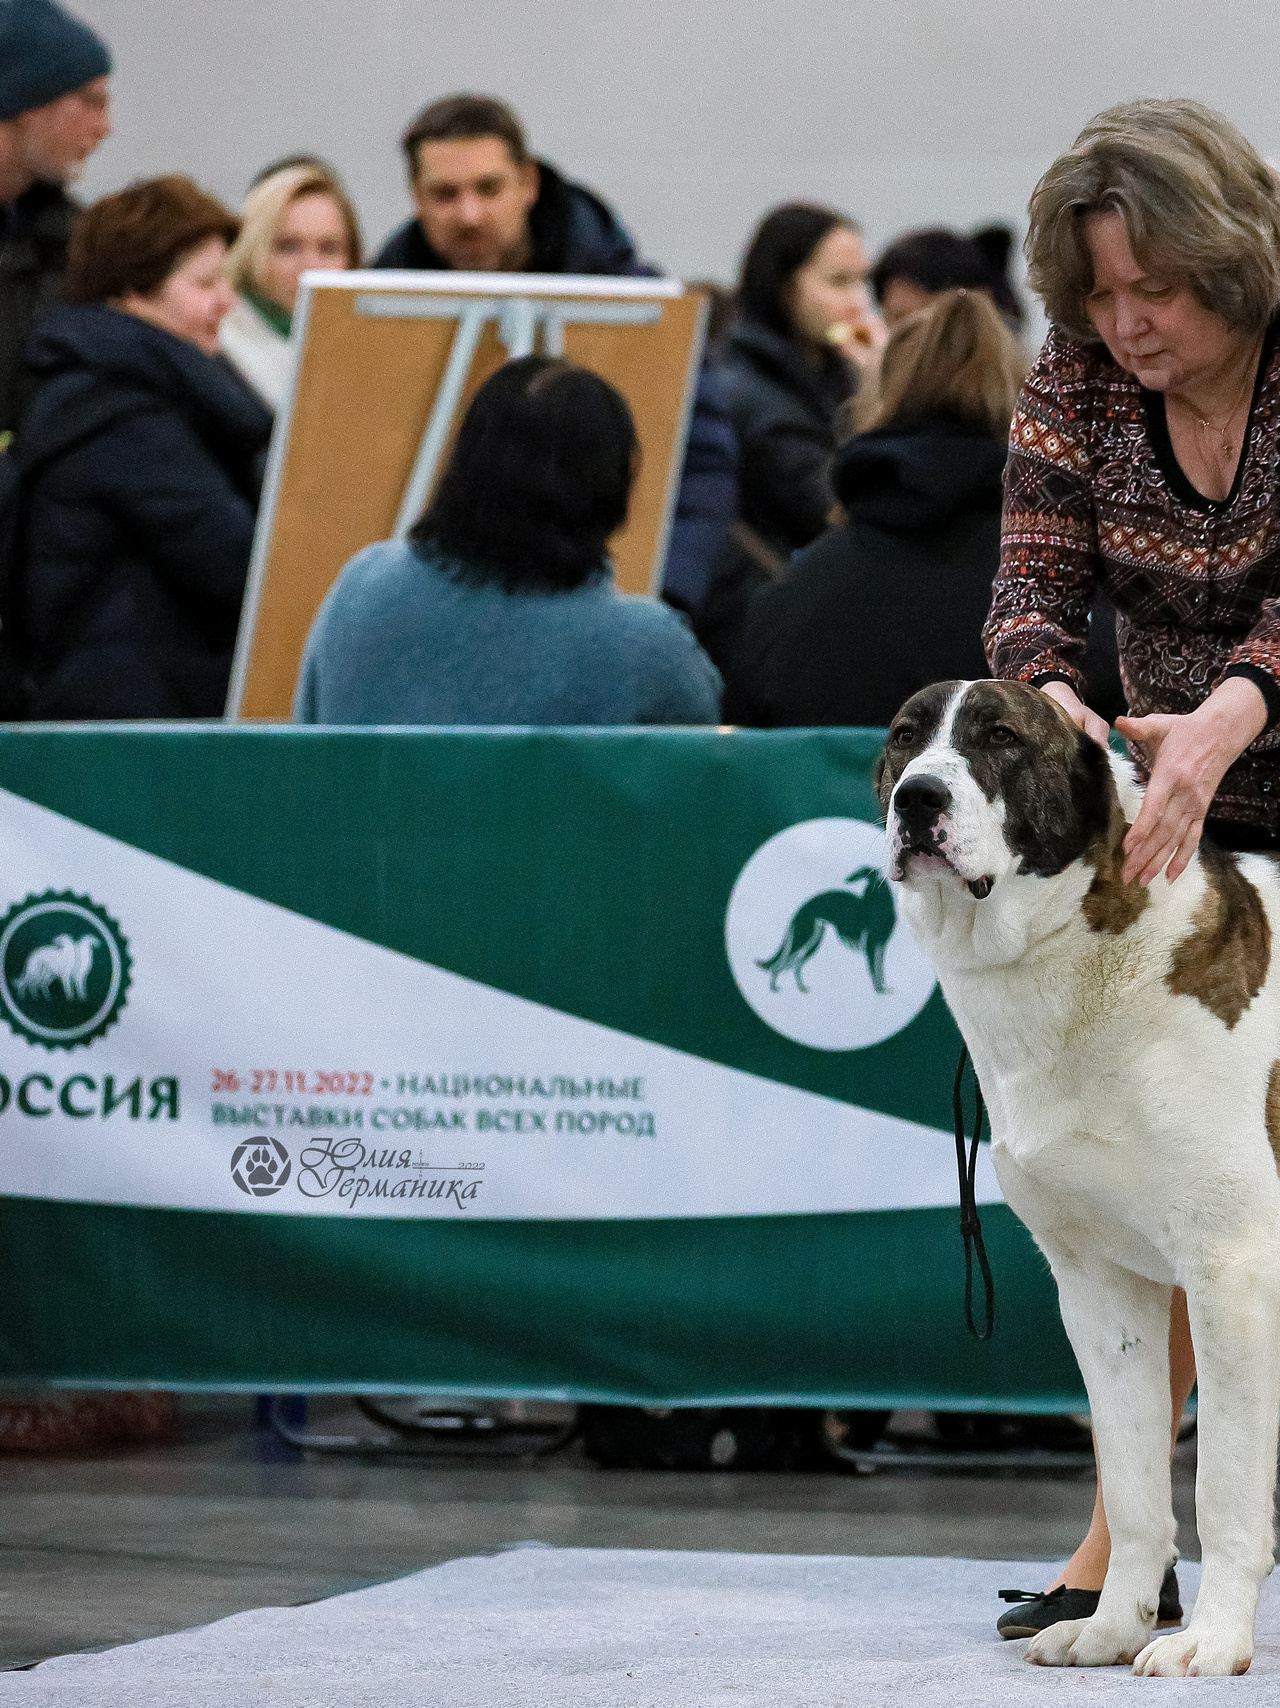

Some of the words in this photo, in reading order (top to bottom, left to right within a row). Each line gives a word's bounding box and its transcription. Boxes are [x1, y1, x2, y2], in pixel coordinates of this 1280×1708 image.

[396, 1070, 646, 1101] НАЦИОНАЛЬНЫЕ
[211, 1102, 364, 1130] ВЫСТАВКИ
[370, 1106, 466, 1132] СОБАК
[476, 1108, 546, 1132] ВСЕХ
[555, 1109, 657, 1138] ПОРОД
